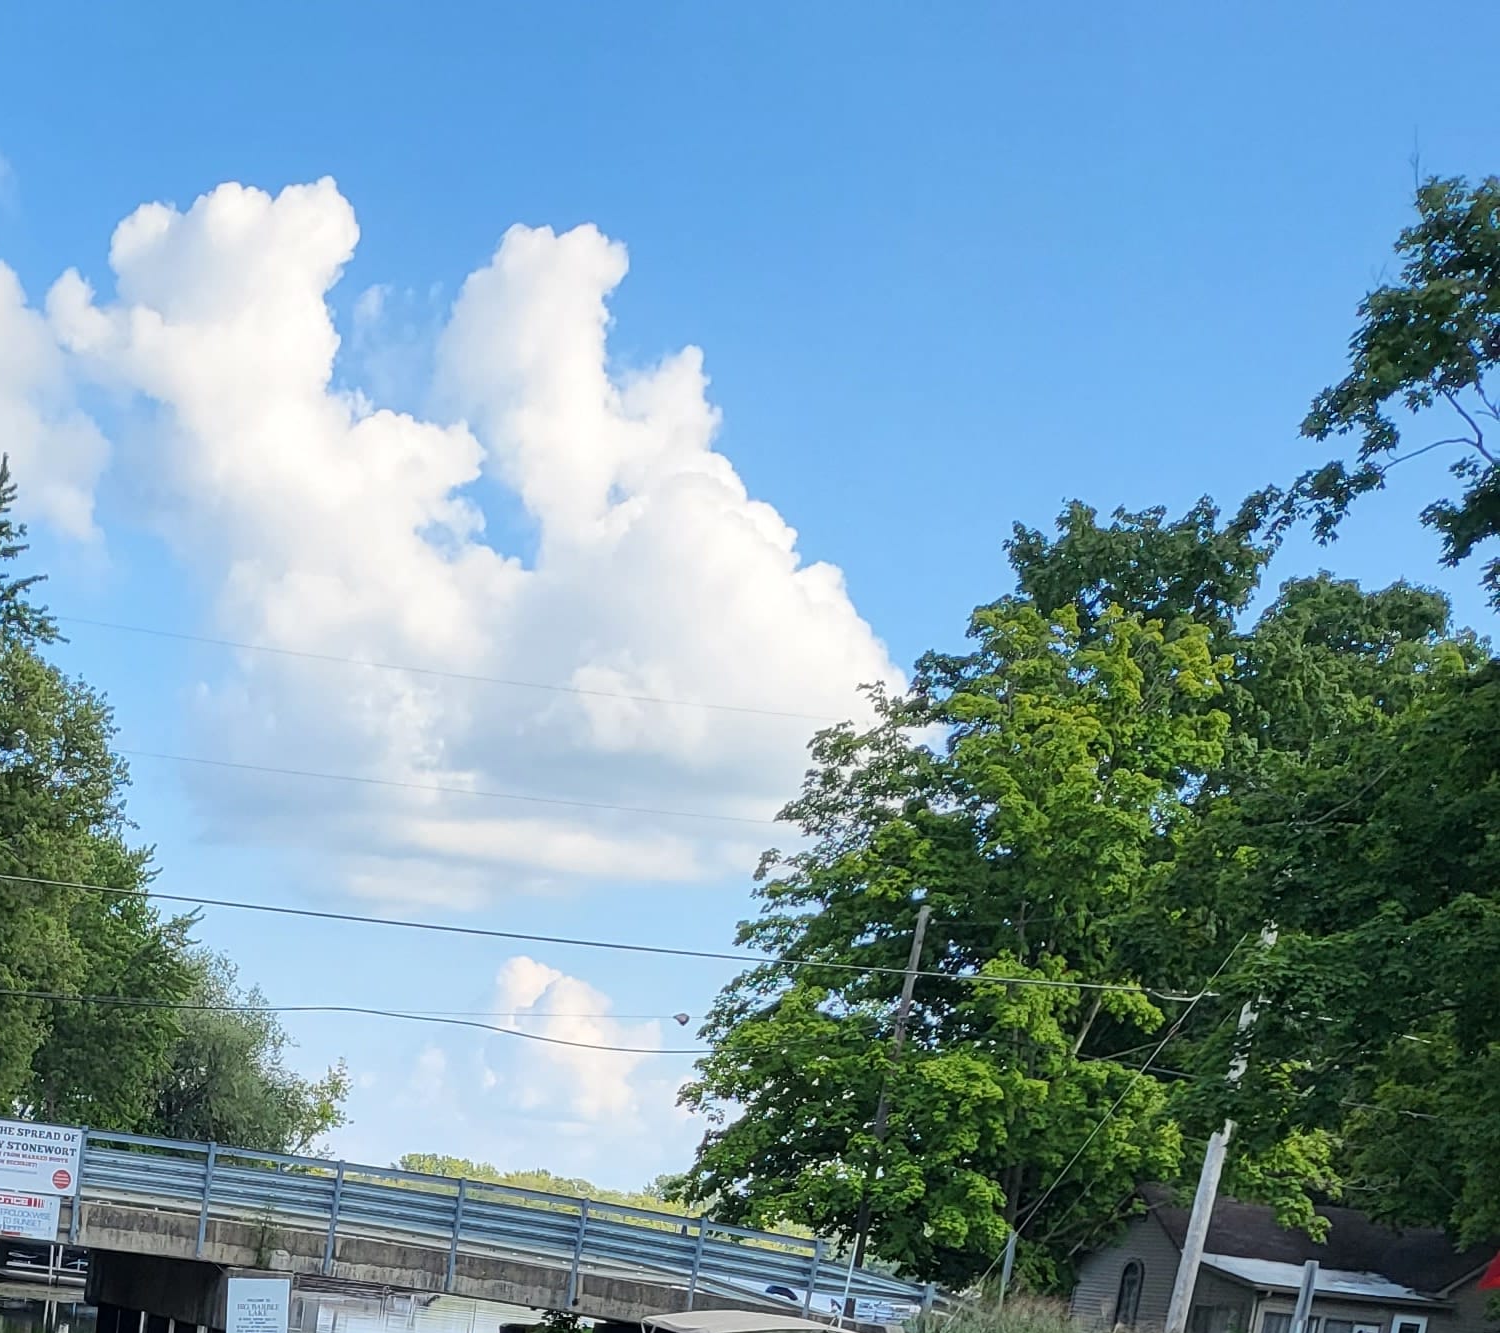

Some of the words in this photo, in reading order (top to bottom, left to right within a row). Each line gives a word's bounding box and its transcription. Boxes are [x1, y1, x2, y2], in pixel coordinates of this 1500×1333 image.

[16, 1128, 61, 1141] SPREAD
[63, 1133, 78, 1143] OF
[6, 1142, 77, 1157] STONEWORT
